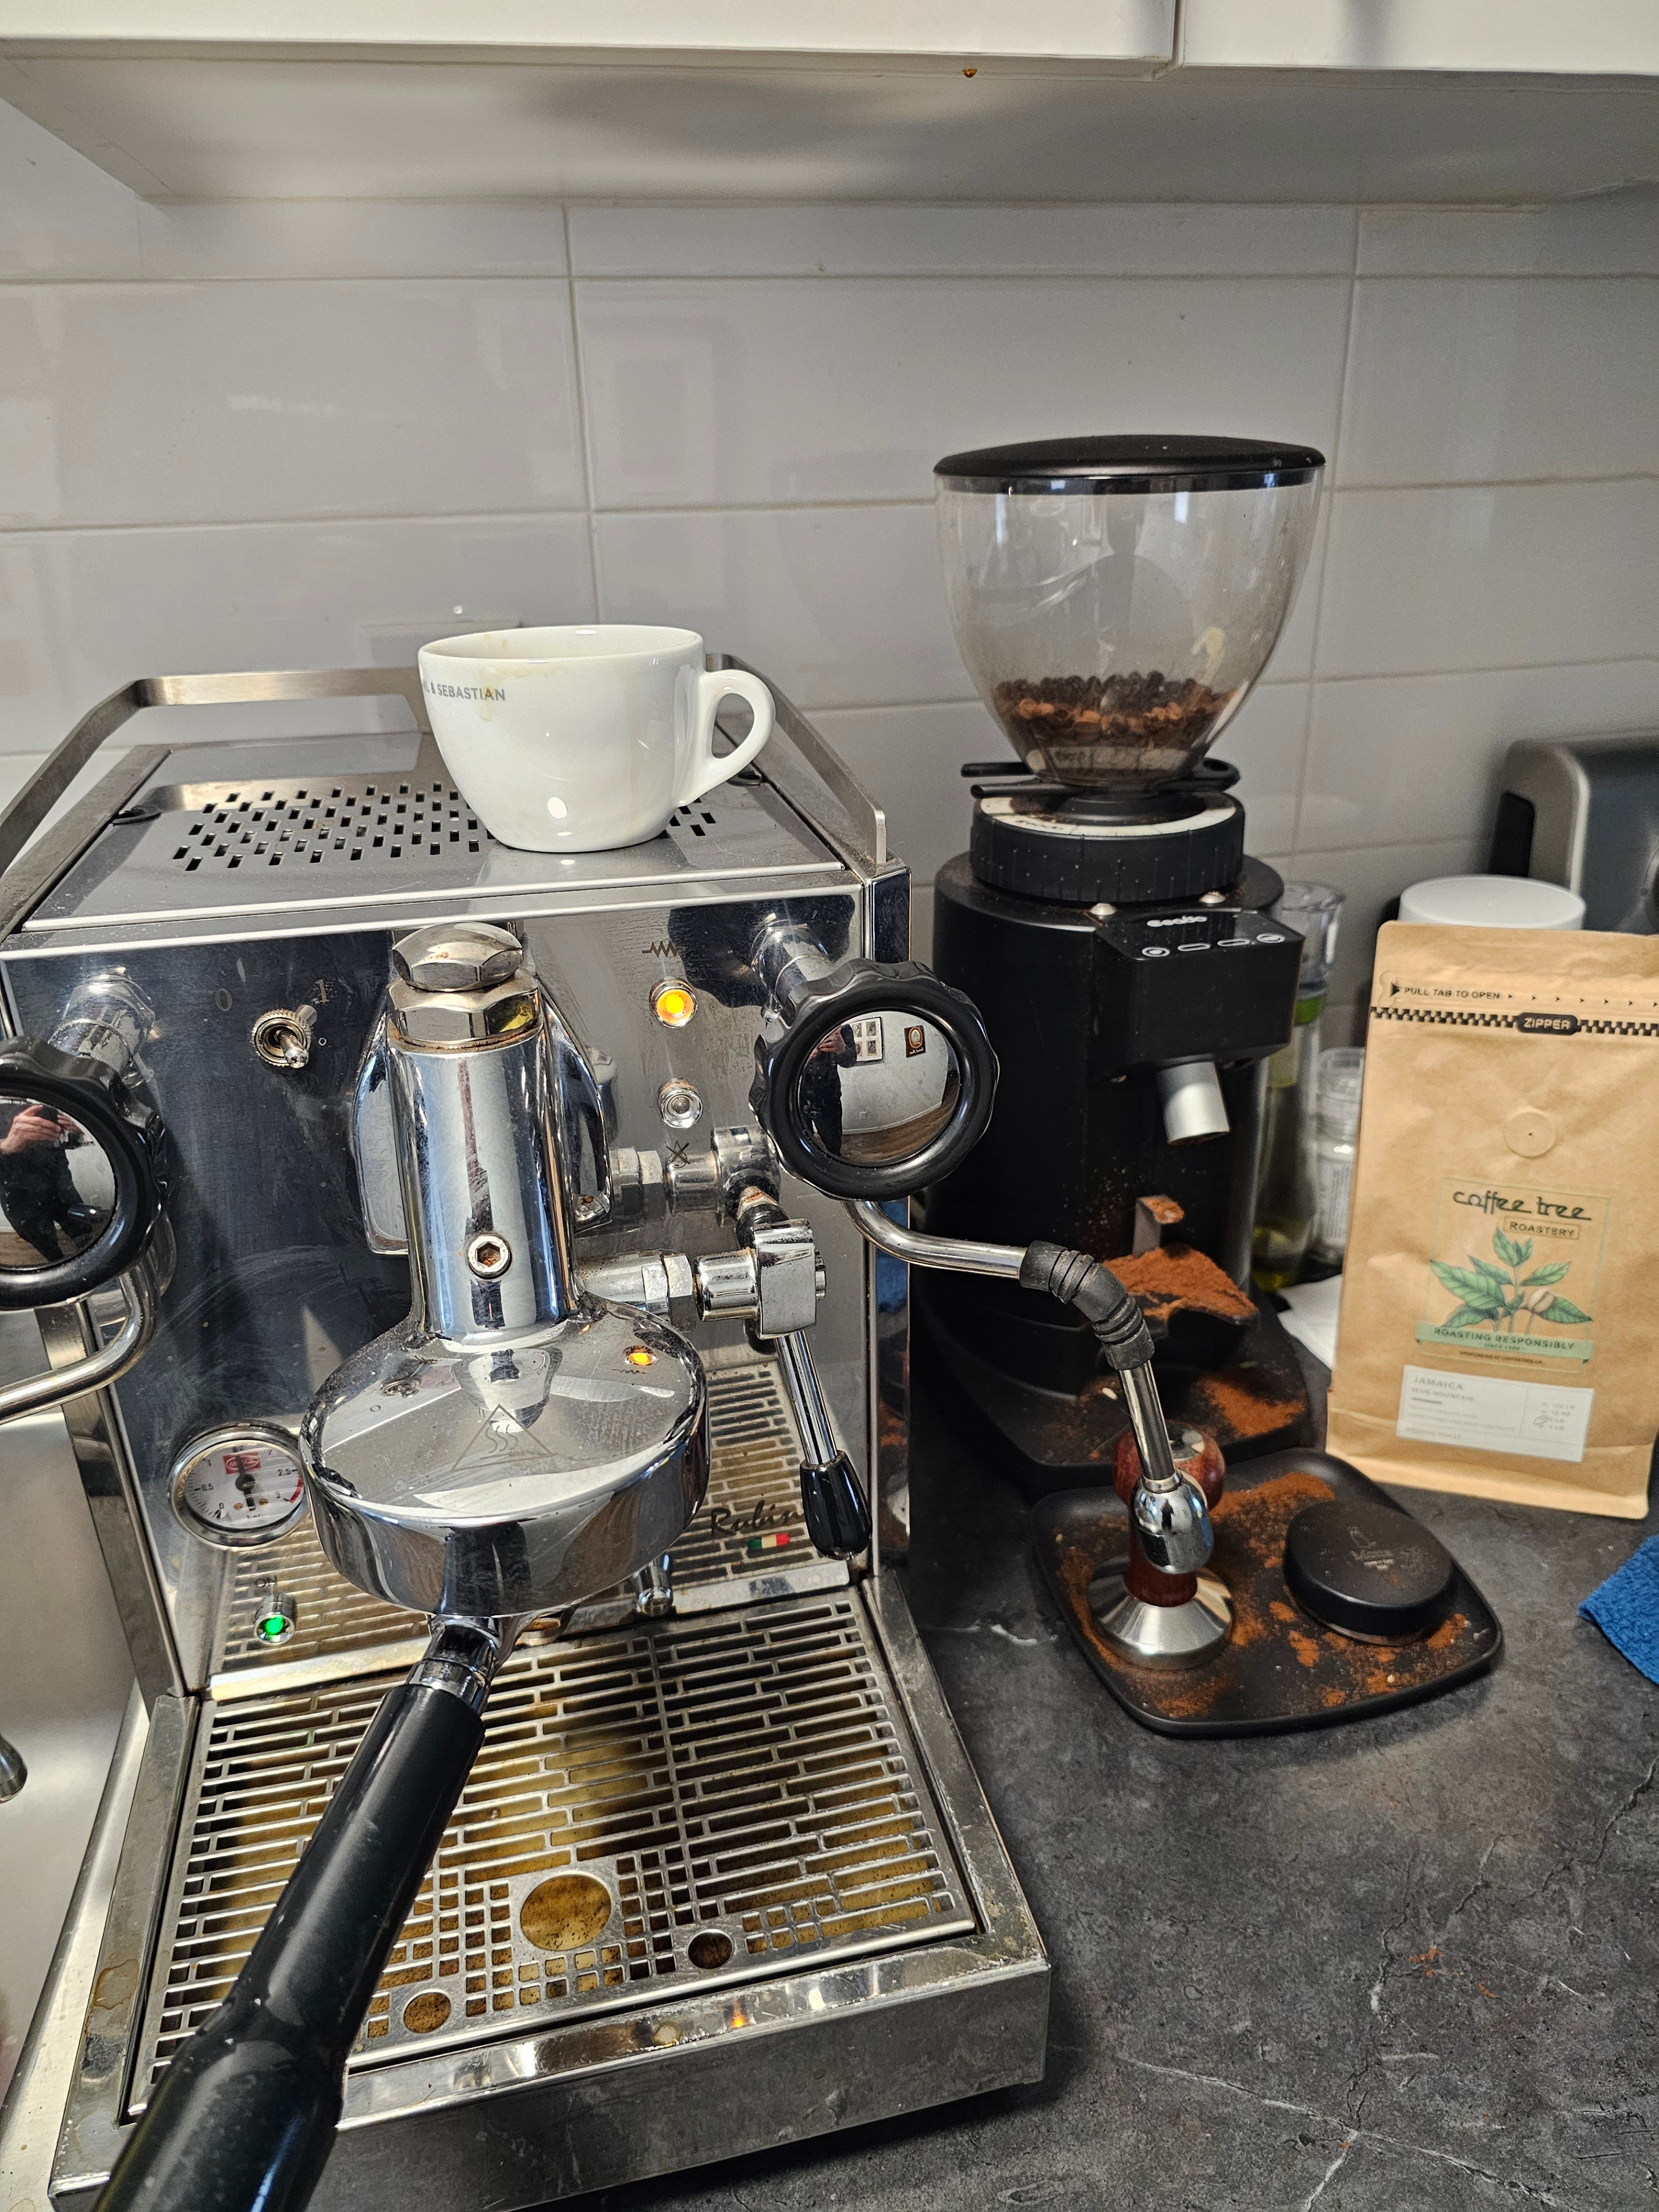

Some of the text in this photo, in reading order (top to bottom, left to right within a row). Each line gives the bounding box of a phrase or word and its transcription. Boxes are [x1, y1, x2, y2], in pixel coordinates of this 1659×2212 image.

[431, 682, 436, 694] &
[437, 683, 506, 701] SEBASTIAN
[1404, 987, 1500, 999] PULL TAB TO OPEN
[1523, 1017, 1571, 1030] ZIPPER
[1453, 1190, 1591, 1221] coffee tree
[1509, 1221, 1575, 1238] ROASTERY
[1433, 1327, 1575, 1350] ROASTING RESPONSIBLY
[1413, 1376, 1463, 1391] JAMAICA
[278, 1468, 291, 1477] 2.5
[202, 1483, 214, 1491] 0.5
